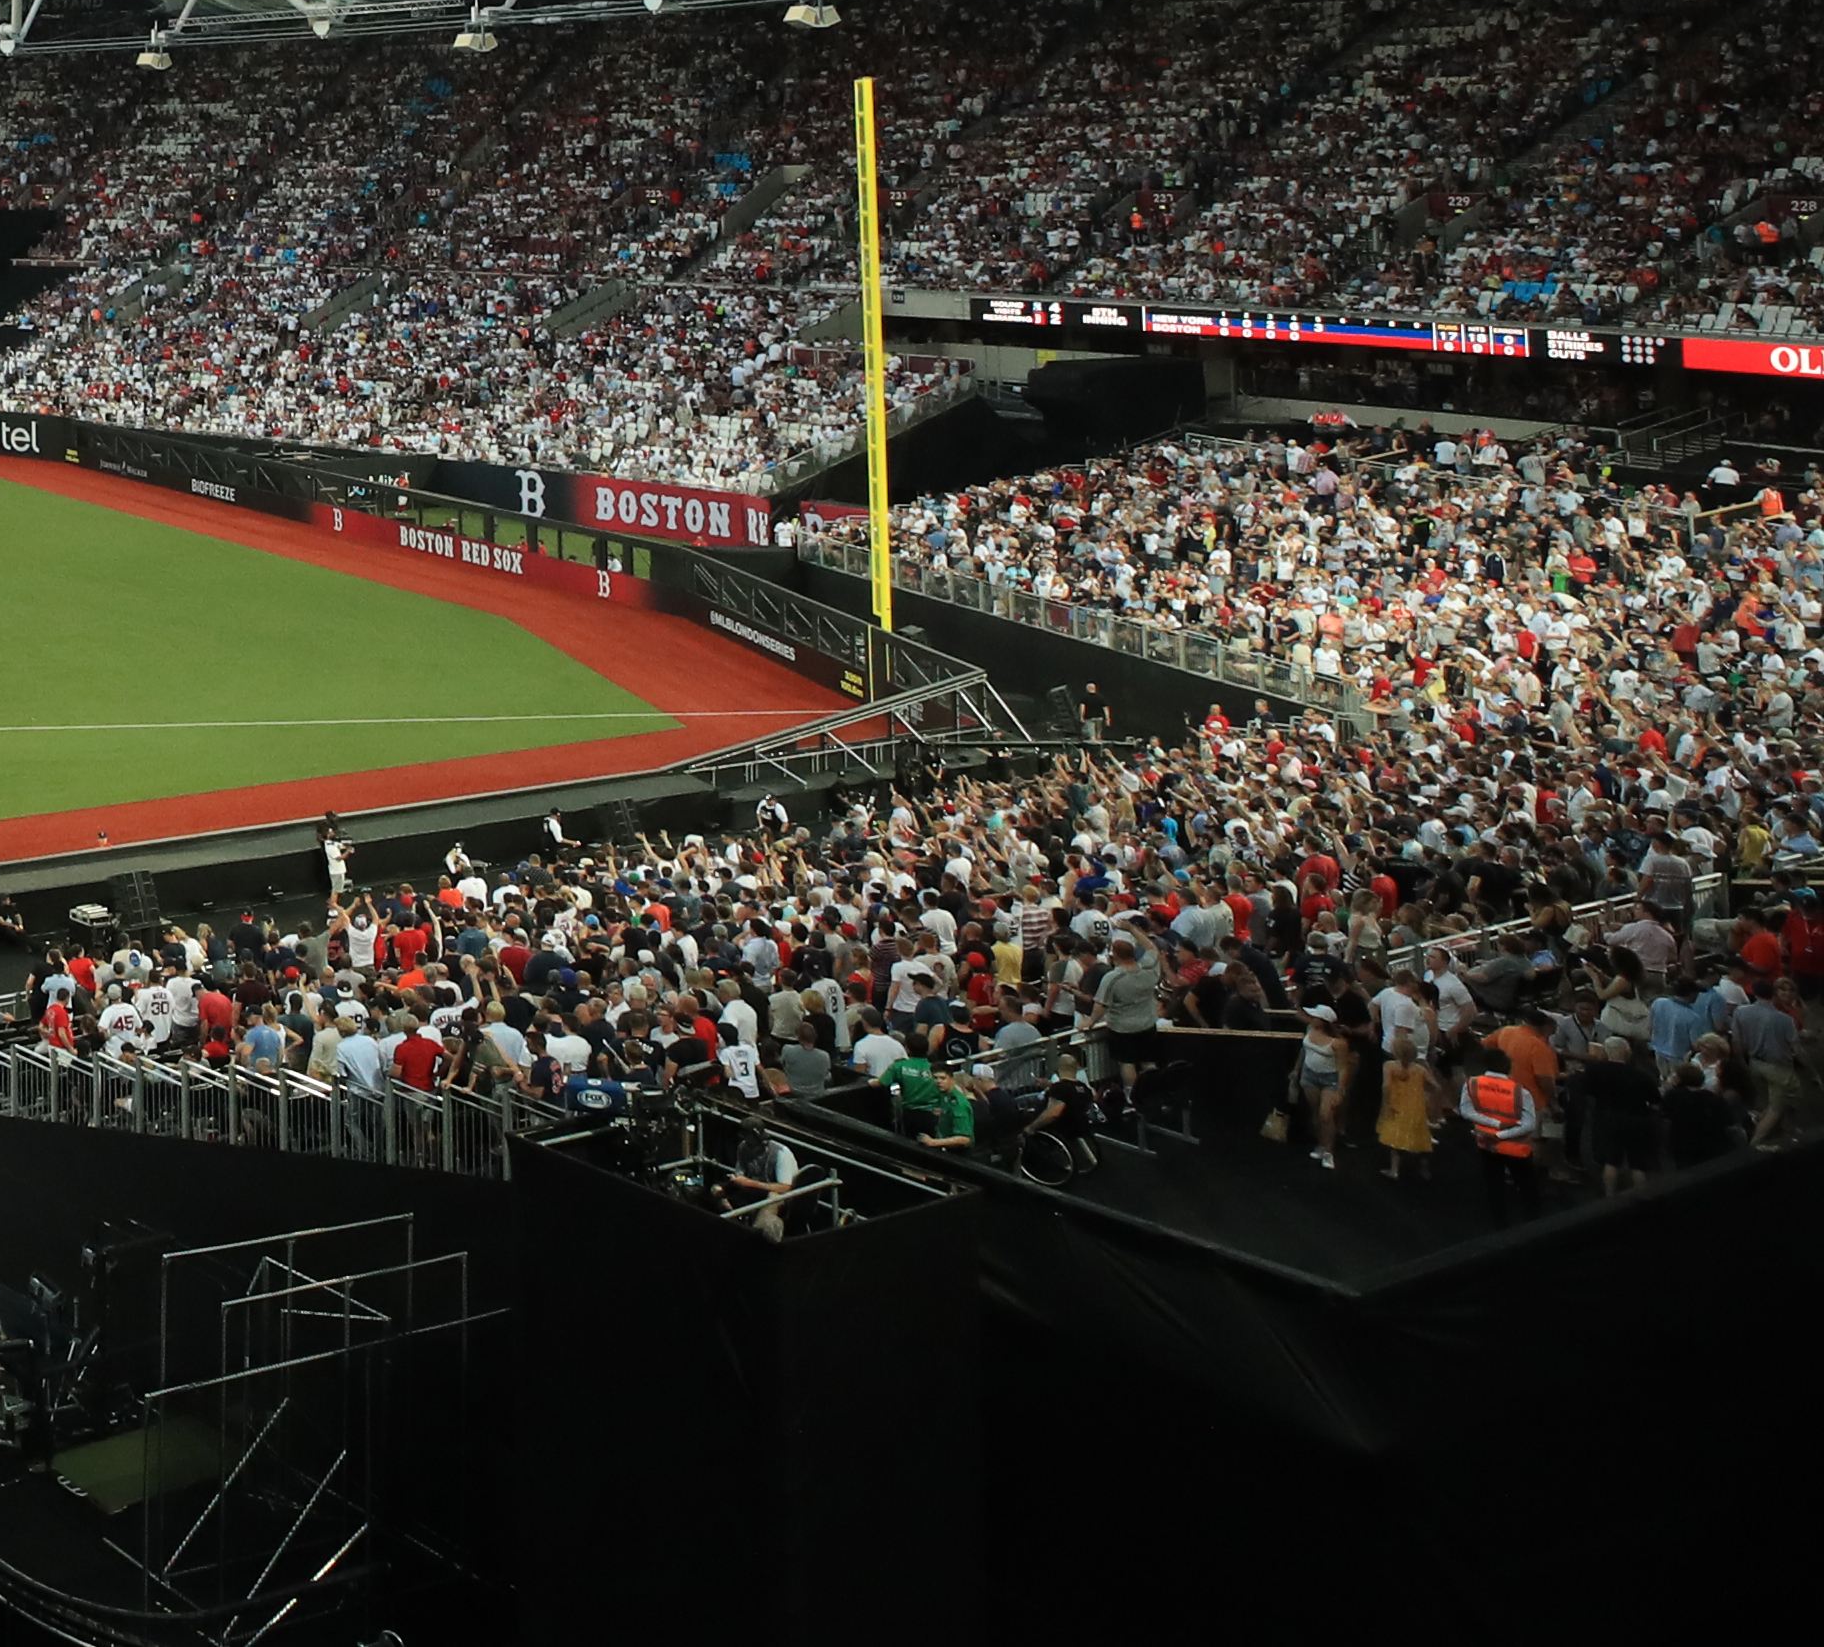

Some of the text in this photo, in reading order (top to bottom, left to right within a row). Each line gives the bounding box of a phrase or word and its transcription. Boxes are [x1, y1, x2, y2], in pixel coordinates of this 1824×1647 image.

[1447, 196, 1470, 207] 229
[1790, 200, 1817, 212] 228
[1048, 302, 1062, 313] 4
[1049, 313, 1062, 325] 2
[1082, 314, 1128, 326] INNING
[1152, 314, 1178, 324] NEW
[1180, 315, 1213, 326] YORK
[1266, 320, 1276, 330] 2
[1313, 323, 1324, 333] 3
[1439, 331, 1459, 341] 17
[1152, 323, 1201, 334] BOSTON
[1546, 330, 1590, 342] BALLS
[1547, 339, 1604, 353] STRIKES
[1547, 349, 1586, 360] OUTS
[1770, 346, 1824, 375] OL
[515, 470, 546, 518] B
[595, 487, 731, 538] BOSTON
[333, 507, 611, 598] B BOSTON RED SOX B
[709, 610, 796, 662] @MLBLONDONSERIES
[151, 1001, 170, 1015] 30
[113, 1015, 133, 1031] 45
[738, 1061, 750, 1077] 3
